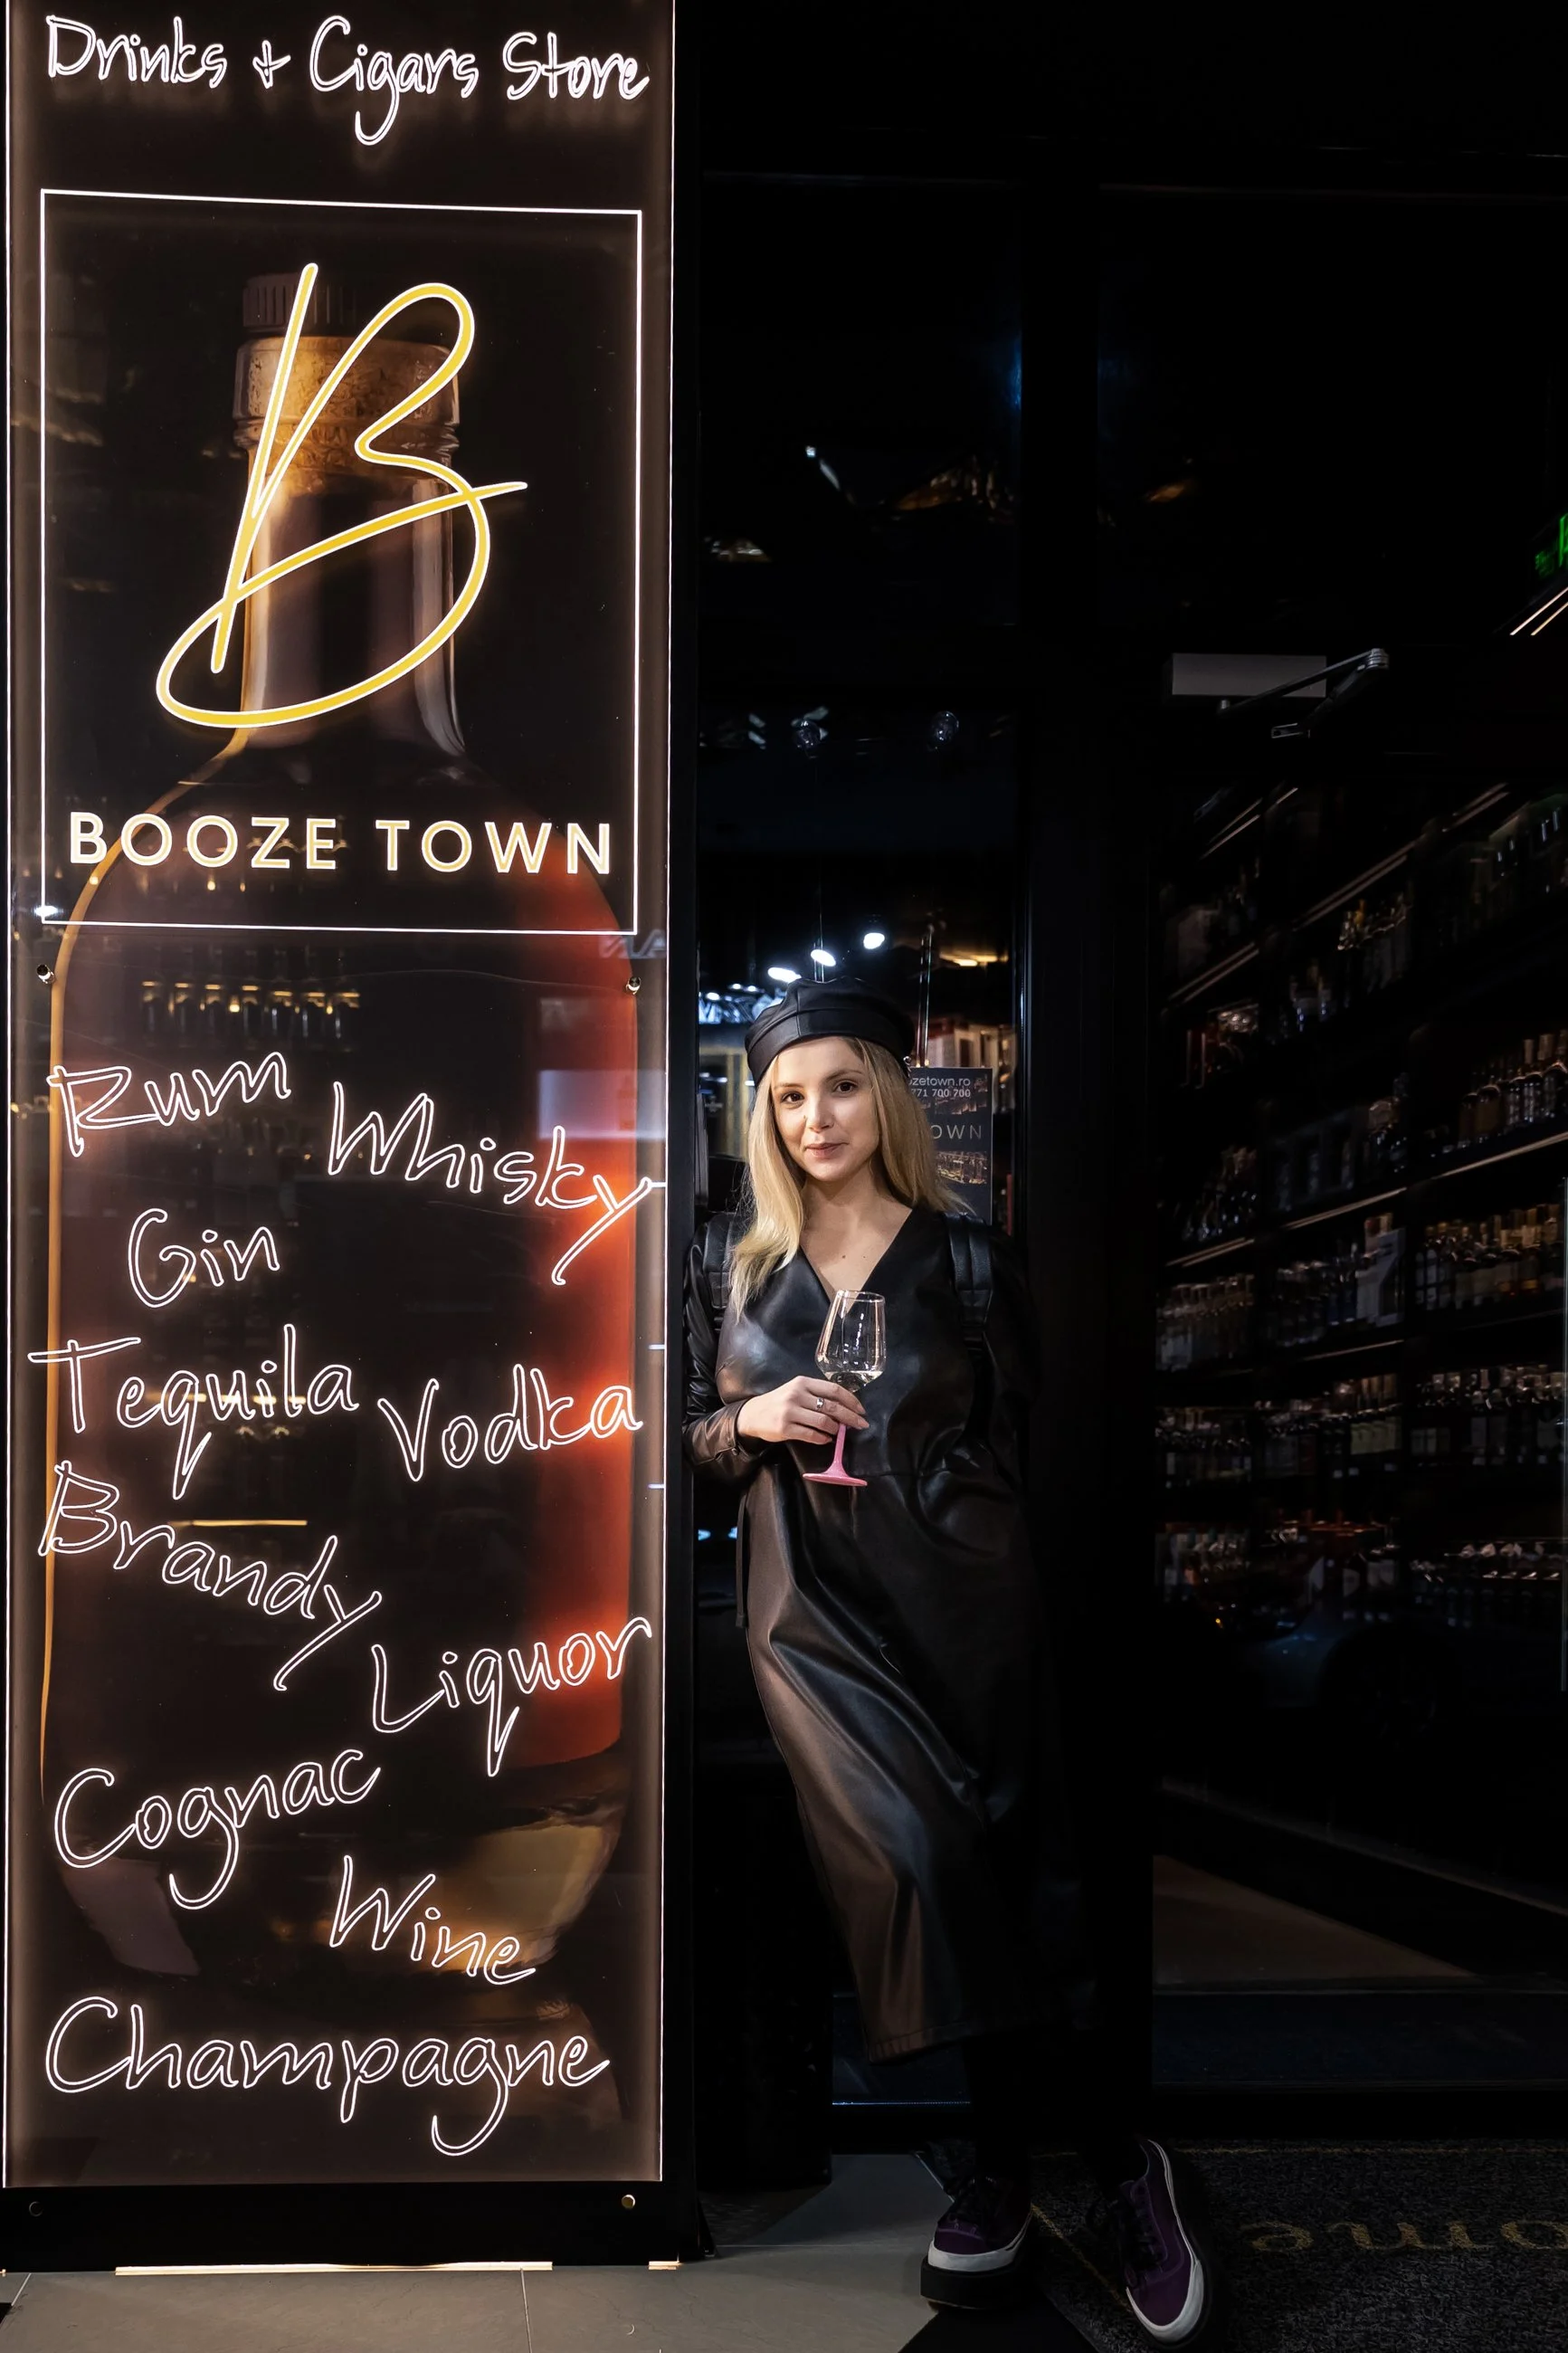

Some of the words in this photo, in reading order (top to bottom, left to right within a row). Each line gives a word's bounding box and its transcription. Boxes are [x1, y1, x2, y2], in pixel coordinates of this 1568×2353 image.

[46, 15, 227, 88] Drinks
[310, 16, 479, 145] Cigars
[503, 33, 650, 100] Store
[156, 262, 527, 729] B
[71, 812, 336, 869] BOOZE
[375, 820, 609, 874] TOWN
[46, 1053, 291, 1157] Rum
[932, 1089, 950, 1097] 700
[953, 1089, 971, 1097] 700
[328, 1081, 653, 1285] Whisky
[128, 1208, 280, 1308] Gin
[28, 1324, 359, 1499] Tequila
[377, 1364, 643, 1481] Vodka
[39, 1461, 382, 1691] Brandy
[372, 1617, 651, 1777] Liquor
[54, 1749, 381, 1910] Cognac
[329, 1855, 536, 1985] Wine
[46, 1996, 610, 2156] Champagne
